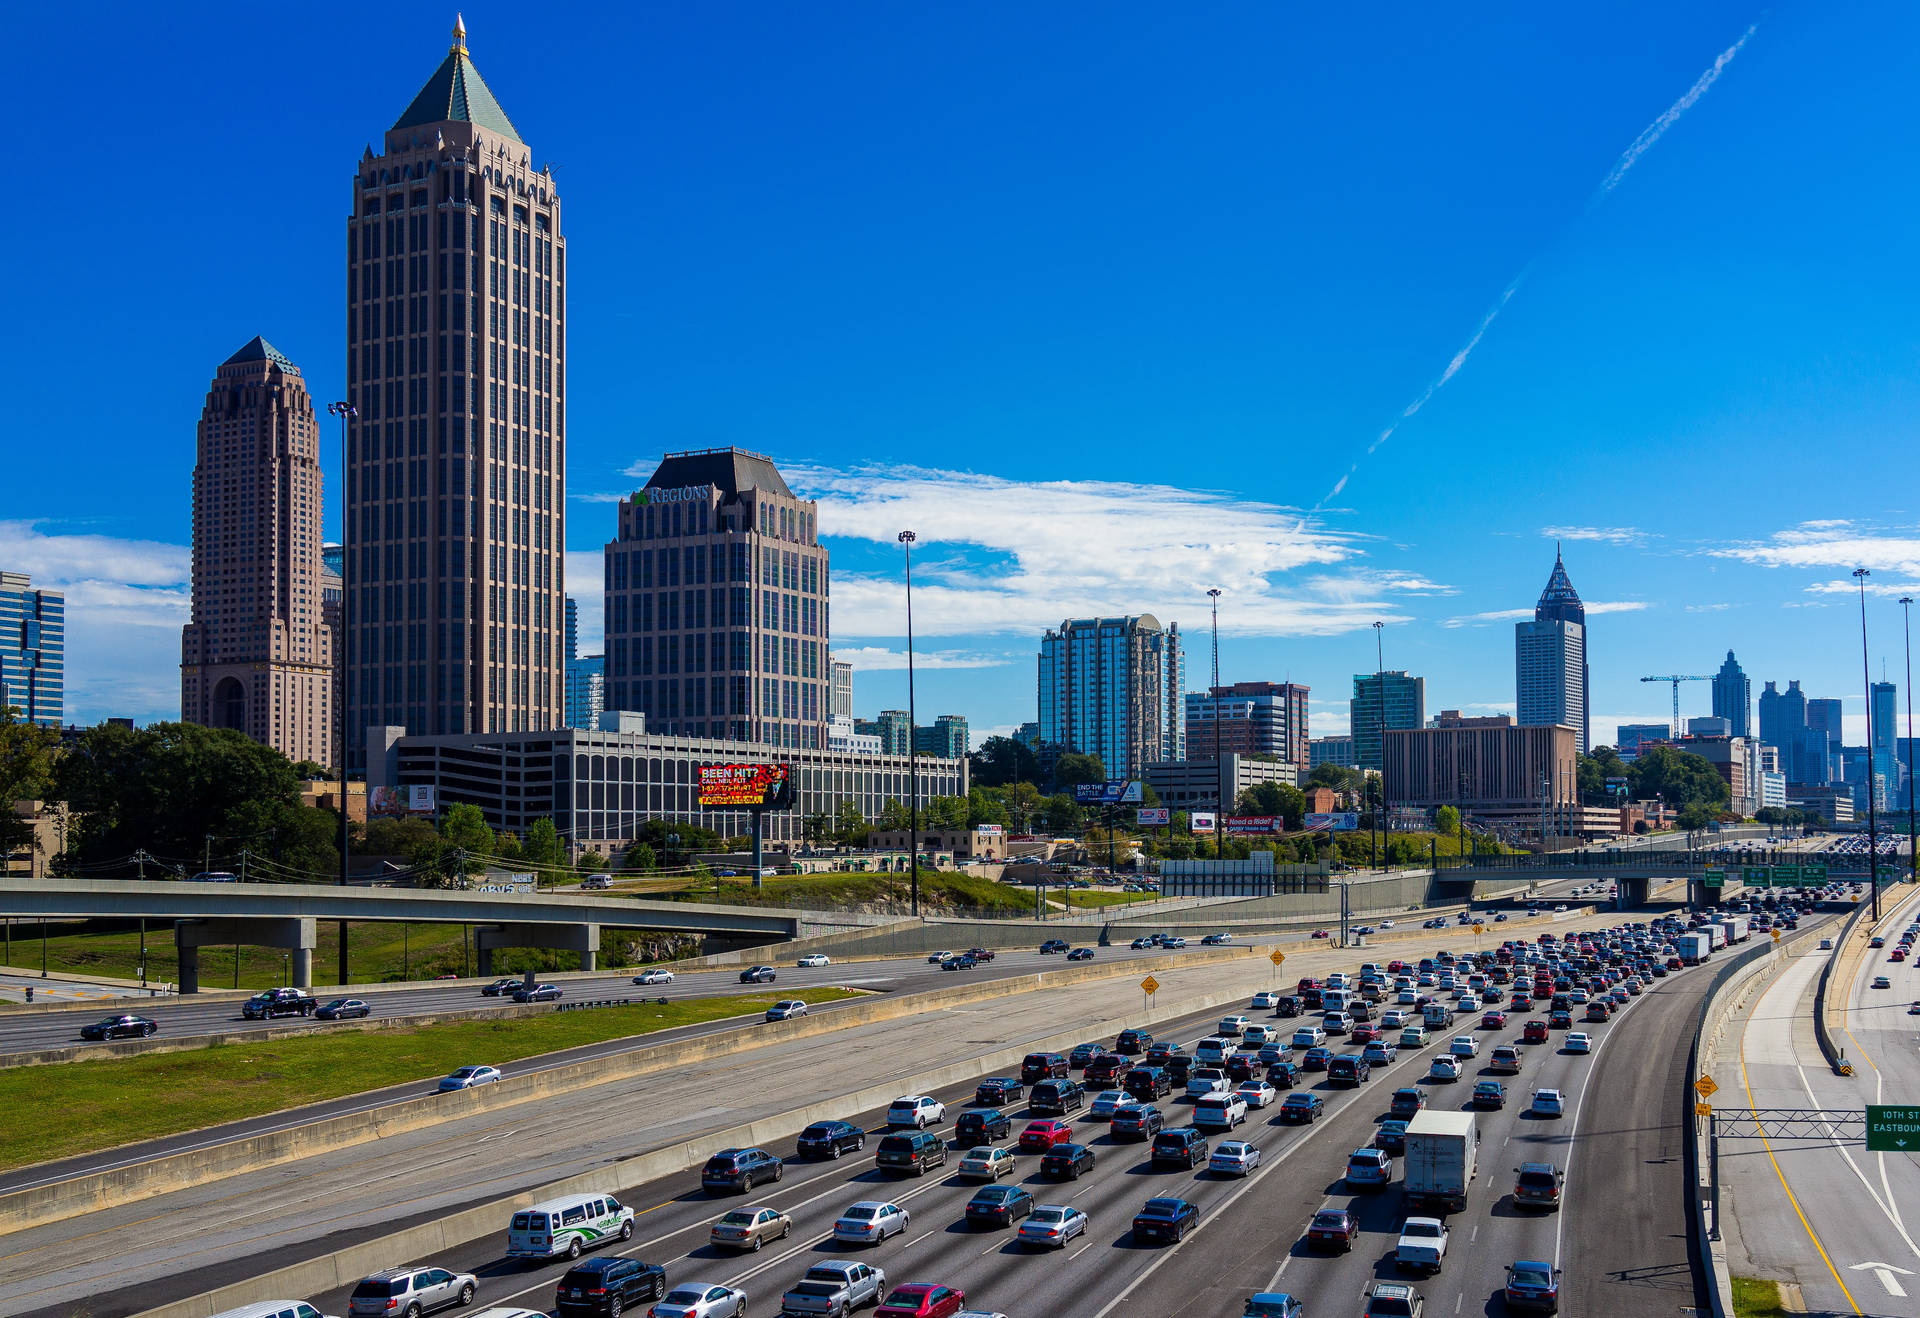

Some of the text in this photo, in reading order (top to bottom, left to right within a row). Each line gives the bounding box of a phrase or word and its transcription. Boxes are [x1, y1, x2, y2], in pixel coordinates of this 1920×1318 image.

[650, 485, 709, 503] REGIONS
[702, 768, 759, 778] BEEN HIT?
[1883, 1111, 1919, 1119] 10TH ST
